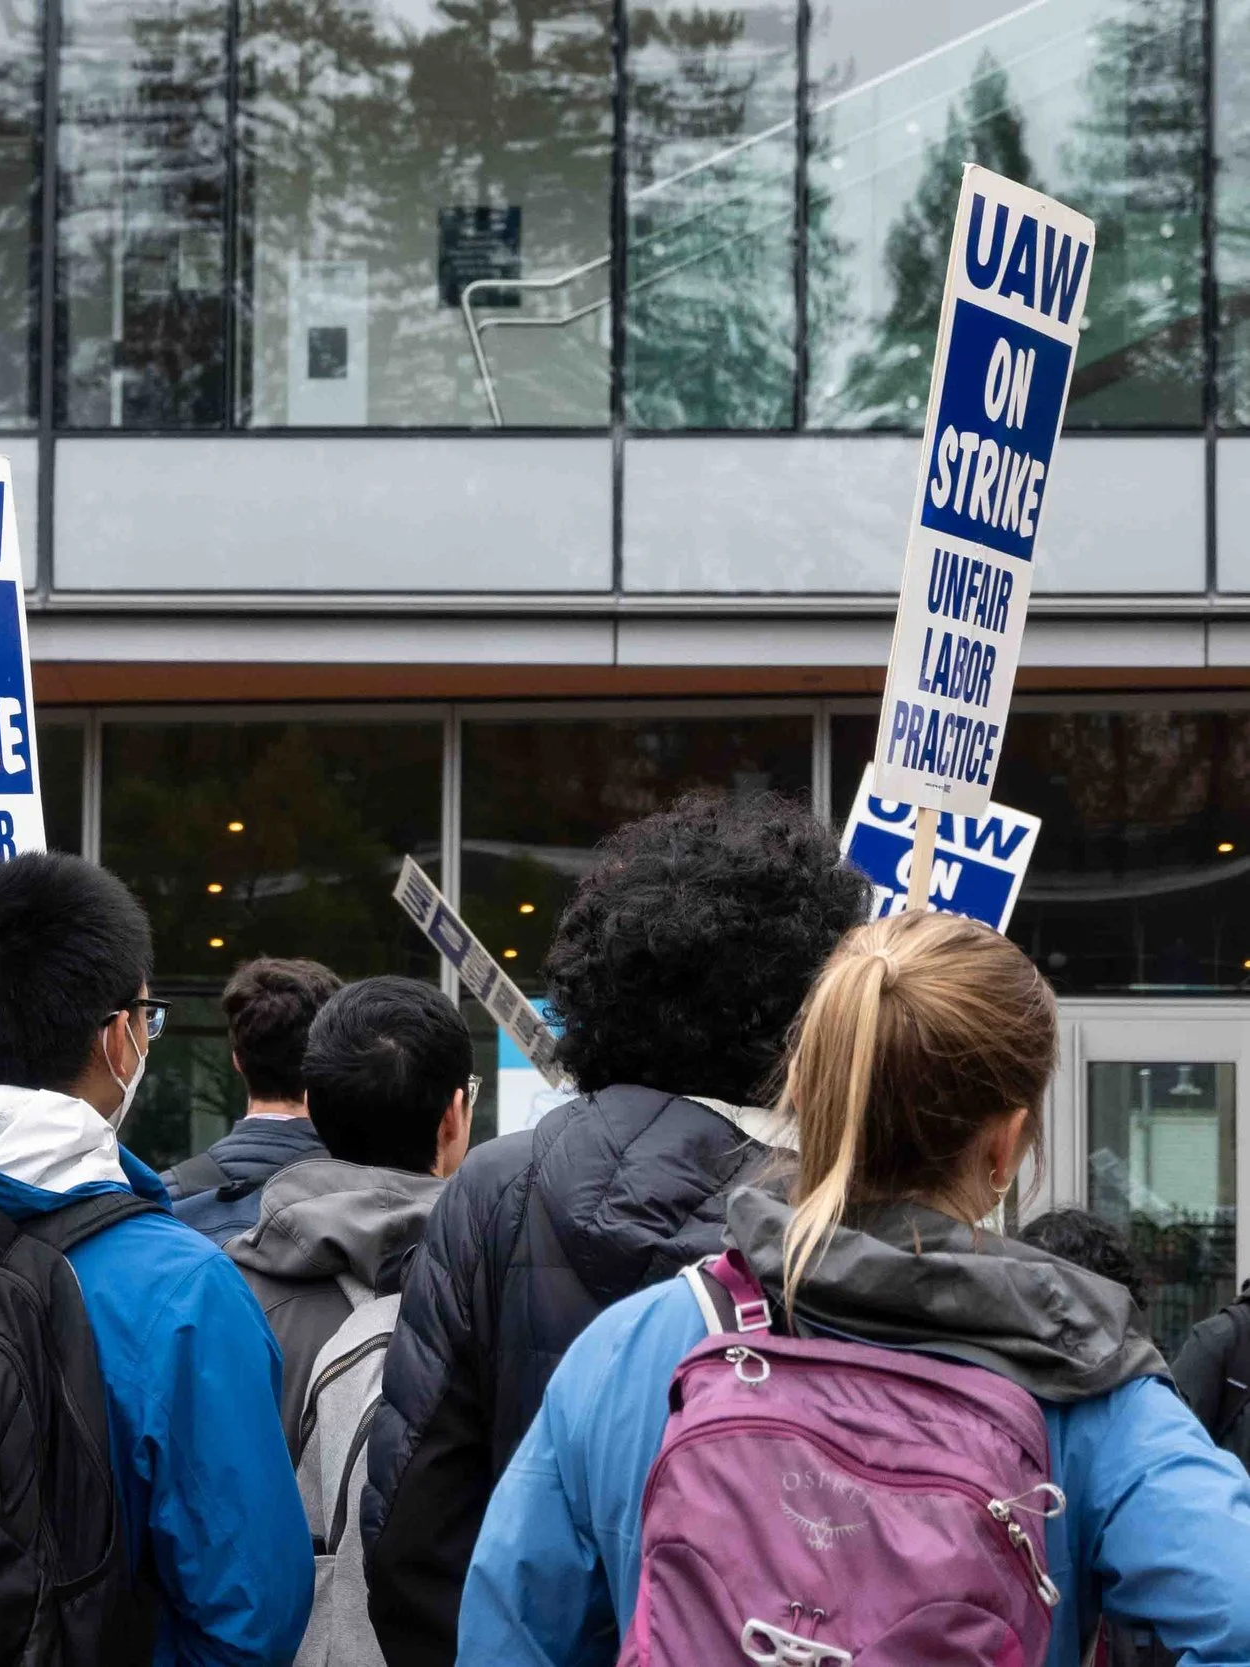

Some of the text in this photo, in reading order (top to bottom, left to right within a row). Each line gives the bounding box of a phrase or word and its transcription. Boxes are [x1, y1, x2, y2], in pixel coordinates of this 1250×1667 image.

[965, 192, 1089, 325] UAW
[984, 337, 1036, 430] ON
[931, 425, 1045, 538] STRIKE
[927, 548, 1014, 634] UNFAIR
[918, 627, 997, 708] LABOR
[887, 700, 999, 786] PRACTICE
